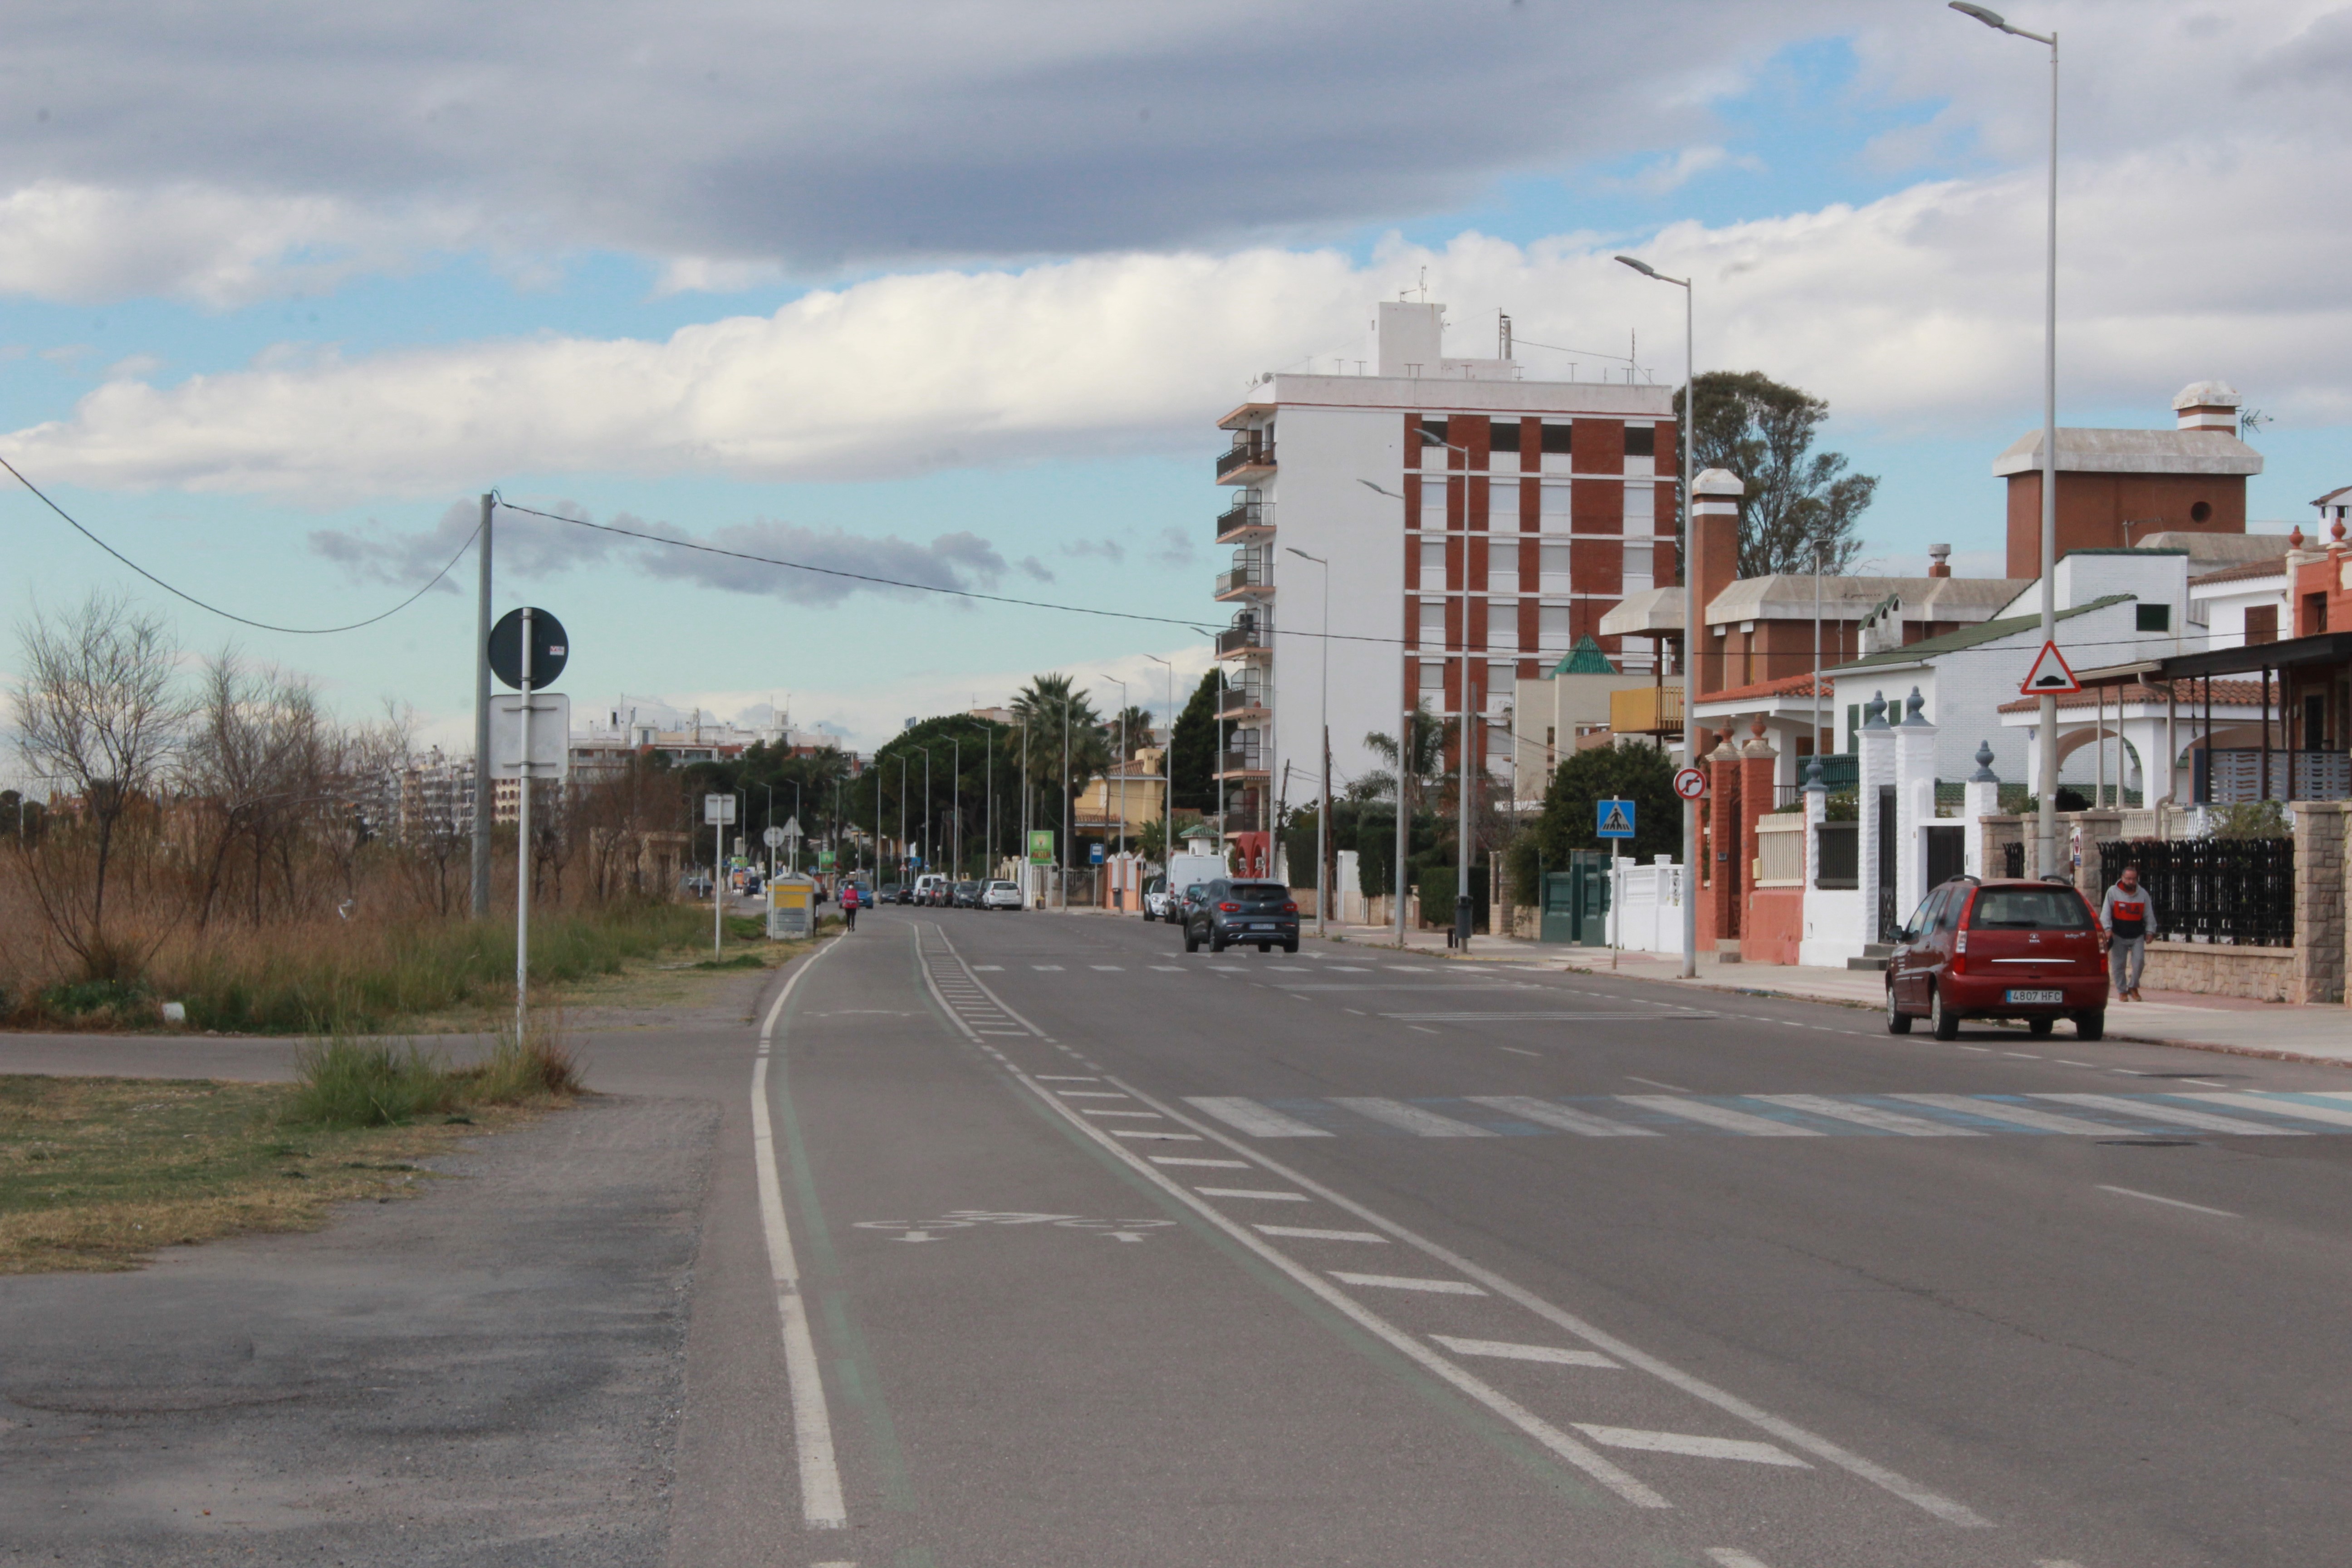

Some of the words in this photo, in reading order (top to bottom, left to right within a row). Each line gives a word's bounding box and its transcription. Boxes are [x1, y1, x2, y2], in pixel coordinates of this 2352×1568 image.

[2119, 904, 2140, 915] FILA
[2013, 991, 2038, 1001] 4807
[2041, 991, 2060, 1001] HFC
